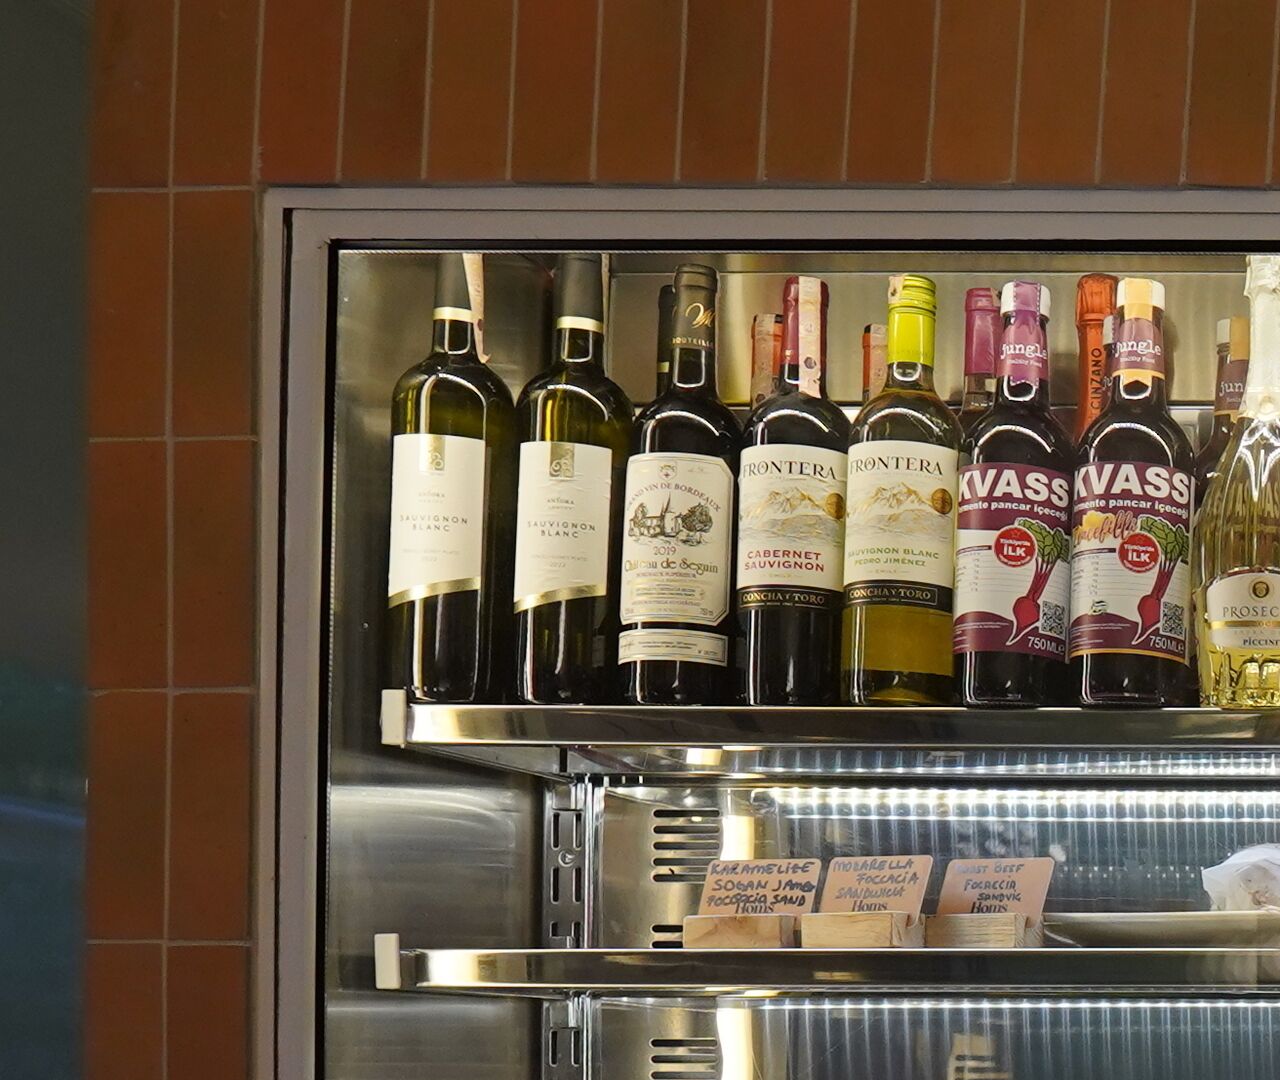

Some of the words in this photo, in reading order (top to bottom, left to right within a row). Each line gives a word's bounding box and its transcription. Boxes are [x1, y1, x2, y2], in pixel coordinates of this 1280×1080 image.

[1115, 339, 1161, 356] jungle
[1089, 347, 1103, 410] CINZANO
[743, 460, 837, 480] FRONTERA
[850, 456, 943, 476] FRONTERA
[959, 469, 1069, 508] KVASS
[1074, 464, 1190, 505] KVASS
[675, 482, 722, 512] BORDEAUX
[990, 501, 1031, 511] pancar
[1108, 498, 1153, 510] pancar
[412, 524, 451, 532] BLANC
[528, 521, 596, 532] SAUVIGNON
[541, 530, 579, 539] BLANC
[653, 546, 677, 556] 2019
[747, 550, 822, 560] CABERNET
[903, 548, 940, 559] BLANC
[661, 559, 677, 569] de
[744, 560, 825, 572] SAUVIGNON
[742, 592, 783, 602] CONCHA
[792, 593, 825, 604] TORO
[849, 588, 888, 599] CONCHA
[899, 588, 932, 600] TORO
[851, 899, 888, 912] Homs
